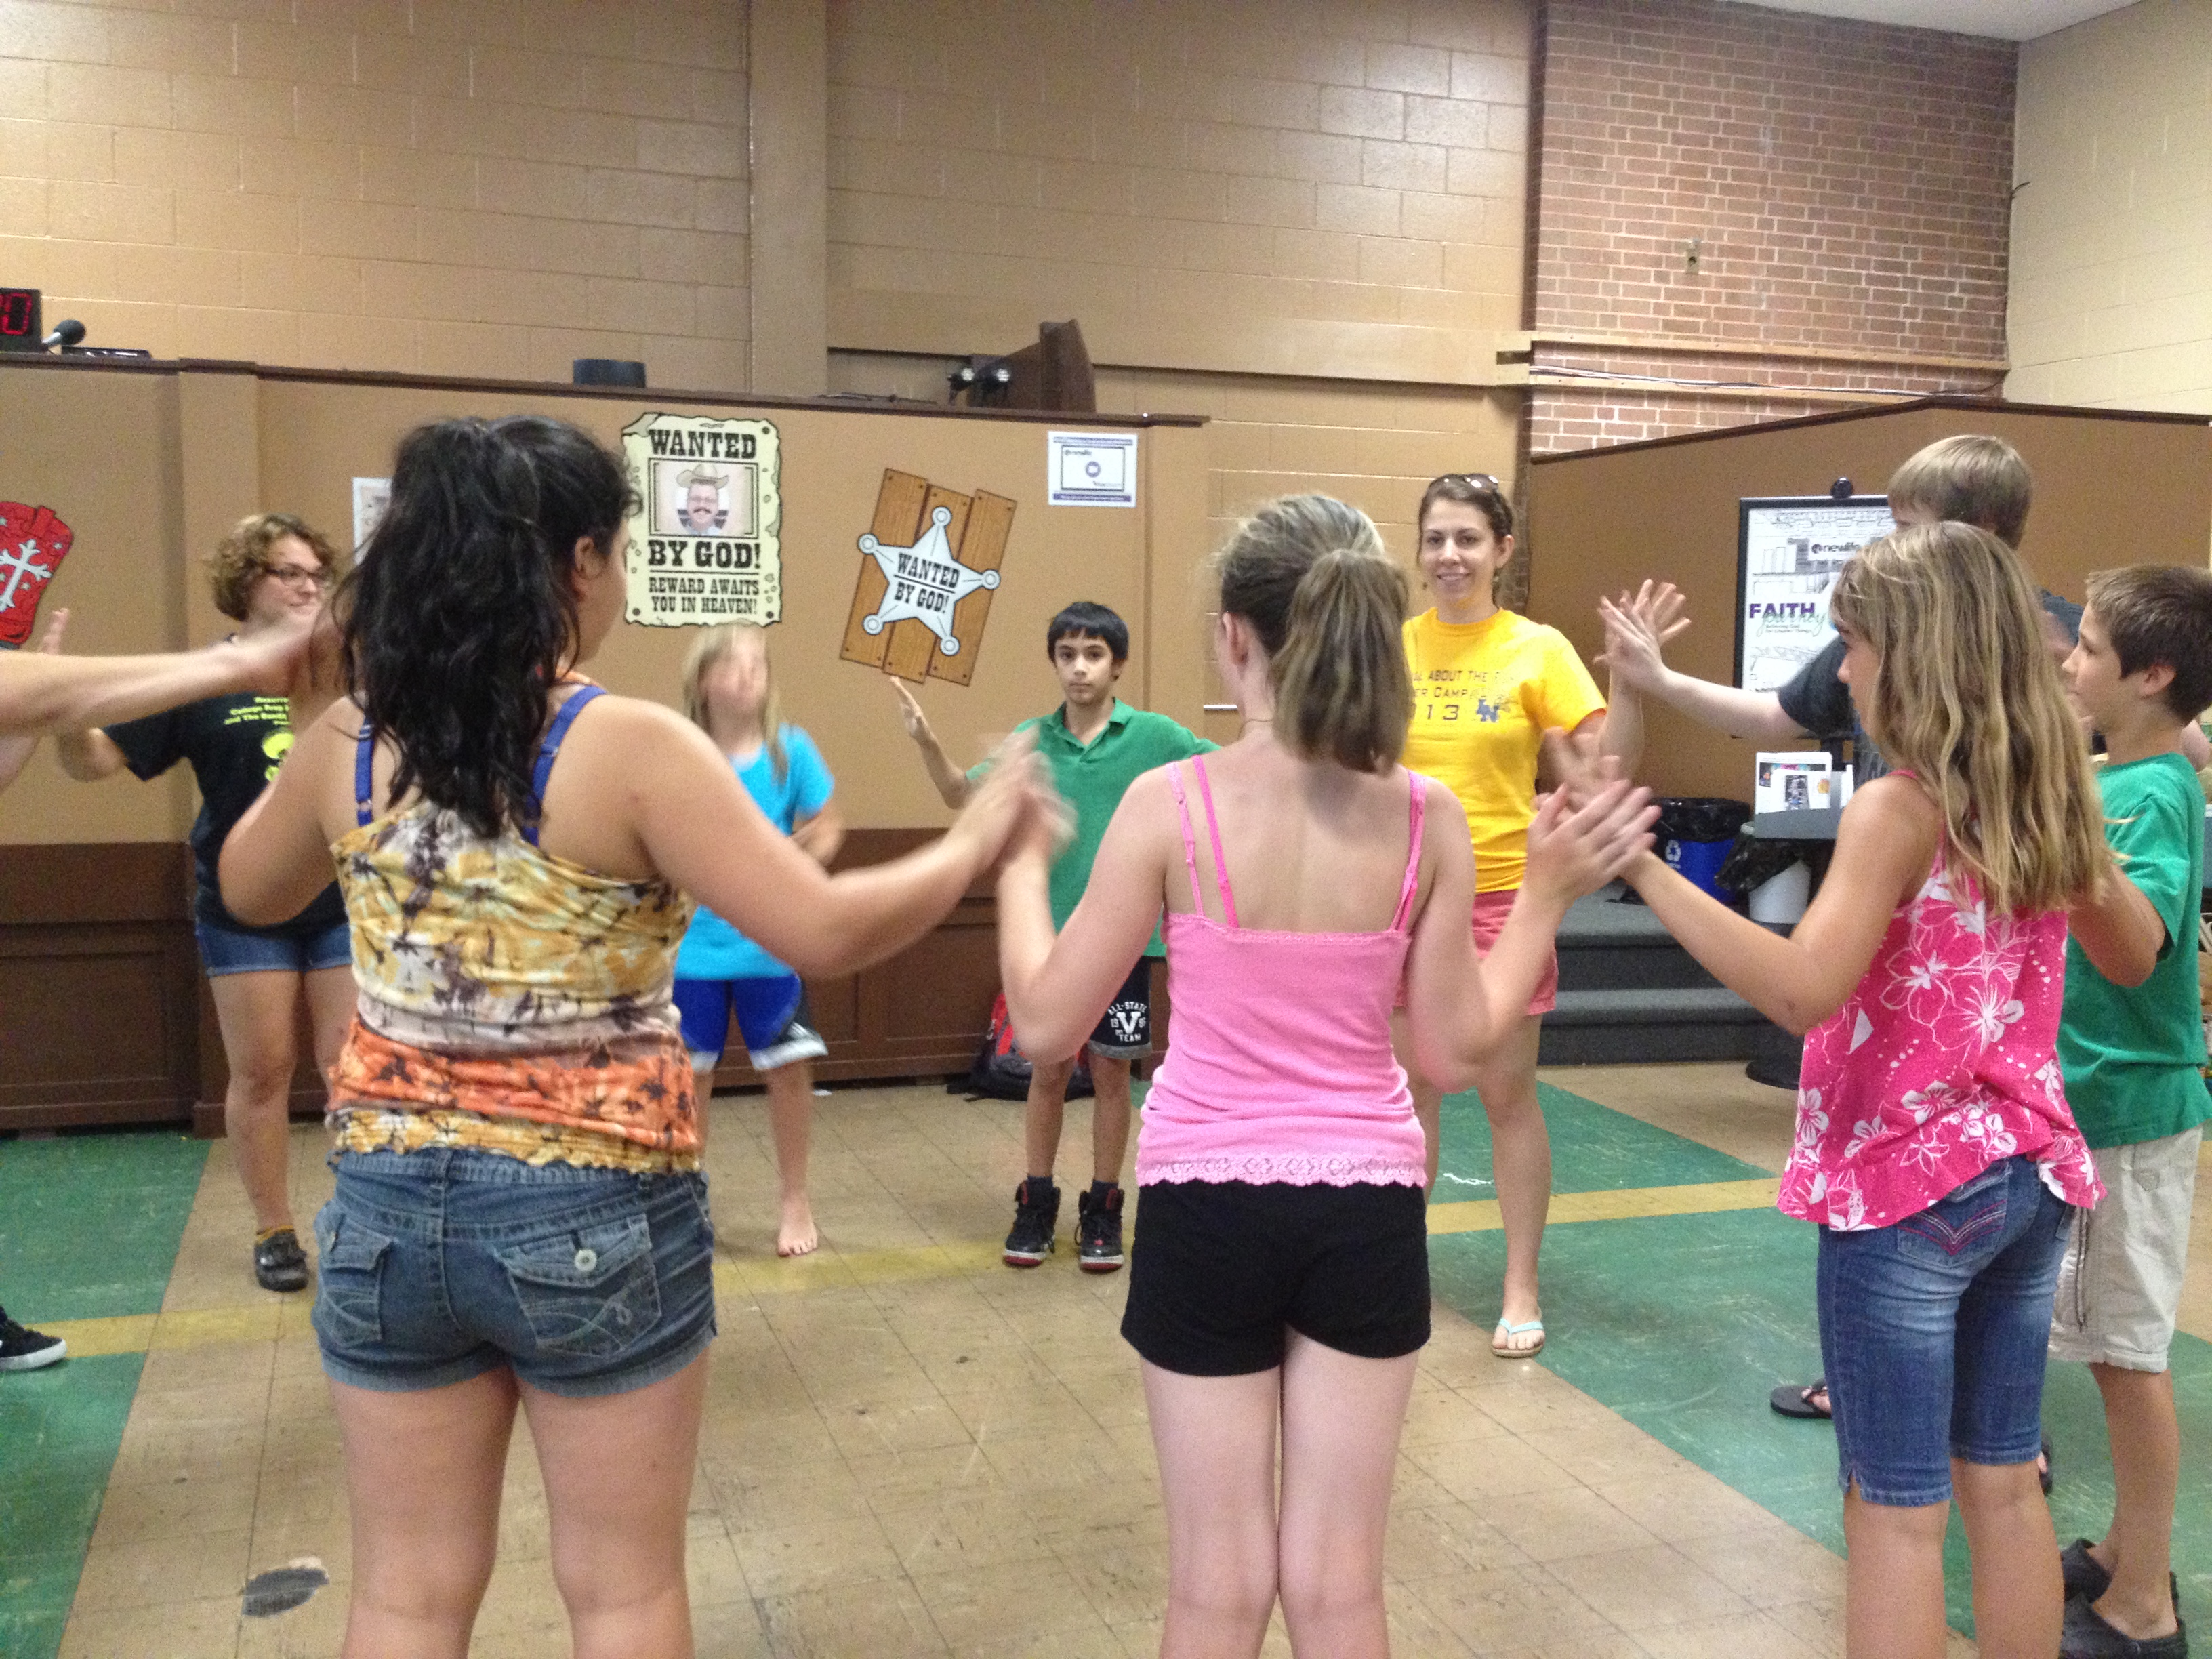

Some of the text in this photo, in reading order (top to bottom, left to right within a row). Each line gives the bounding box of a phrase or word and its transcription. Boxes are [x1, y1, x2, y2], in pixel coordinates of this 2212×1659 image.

[0, 293, 33, 335] 0
[648, 429, 757, 459] WANTED
[648, 539, 761, 569] BY GOD!
[898, 553, 960, 588] WANTED
[649, 577, 760, 595] REWARD AWAITS
[651, 596, 758, 615] YOU IN HEAVEN!
[894, 581, 950, 615] BY GOD!
[1749, 602, 1816, 619] FAITH
[1429, 670, 1463, 682] ABOUT
[1469, 670, 1488, 682] THE
[1116, 1012, 1141, 1034] V
[1119, 1033, 1141, 1042] TEAM
